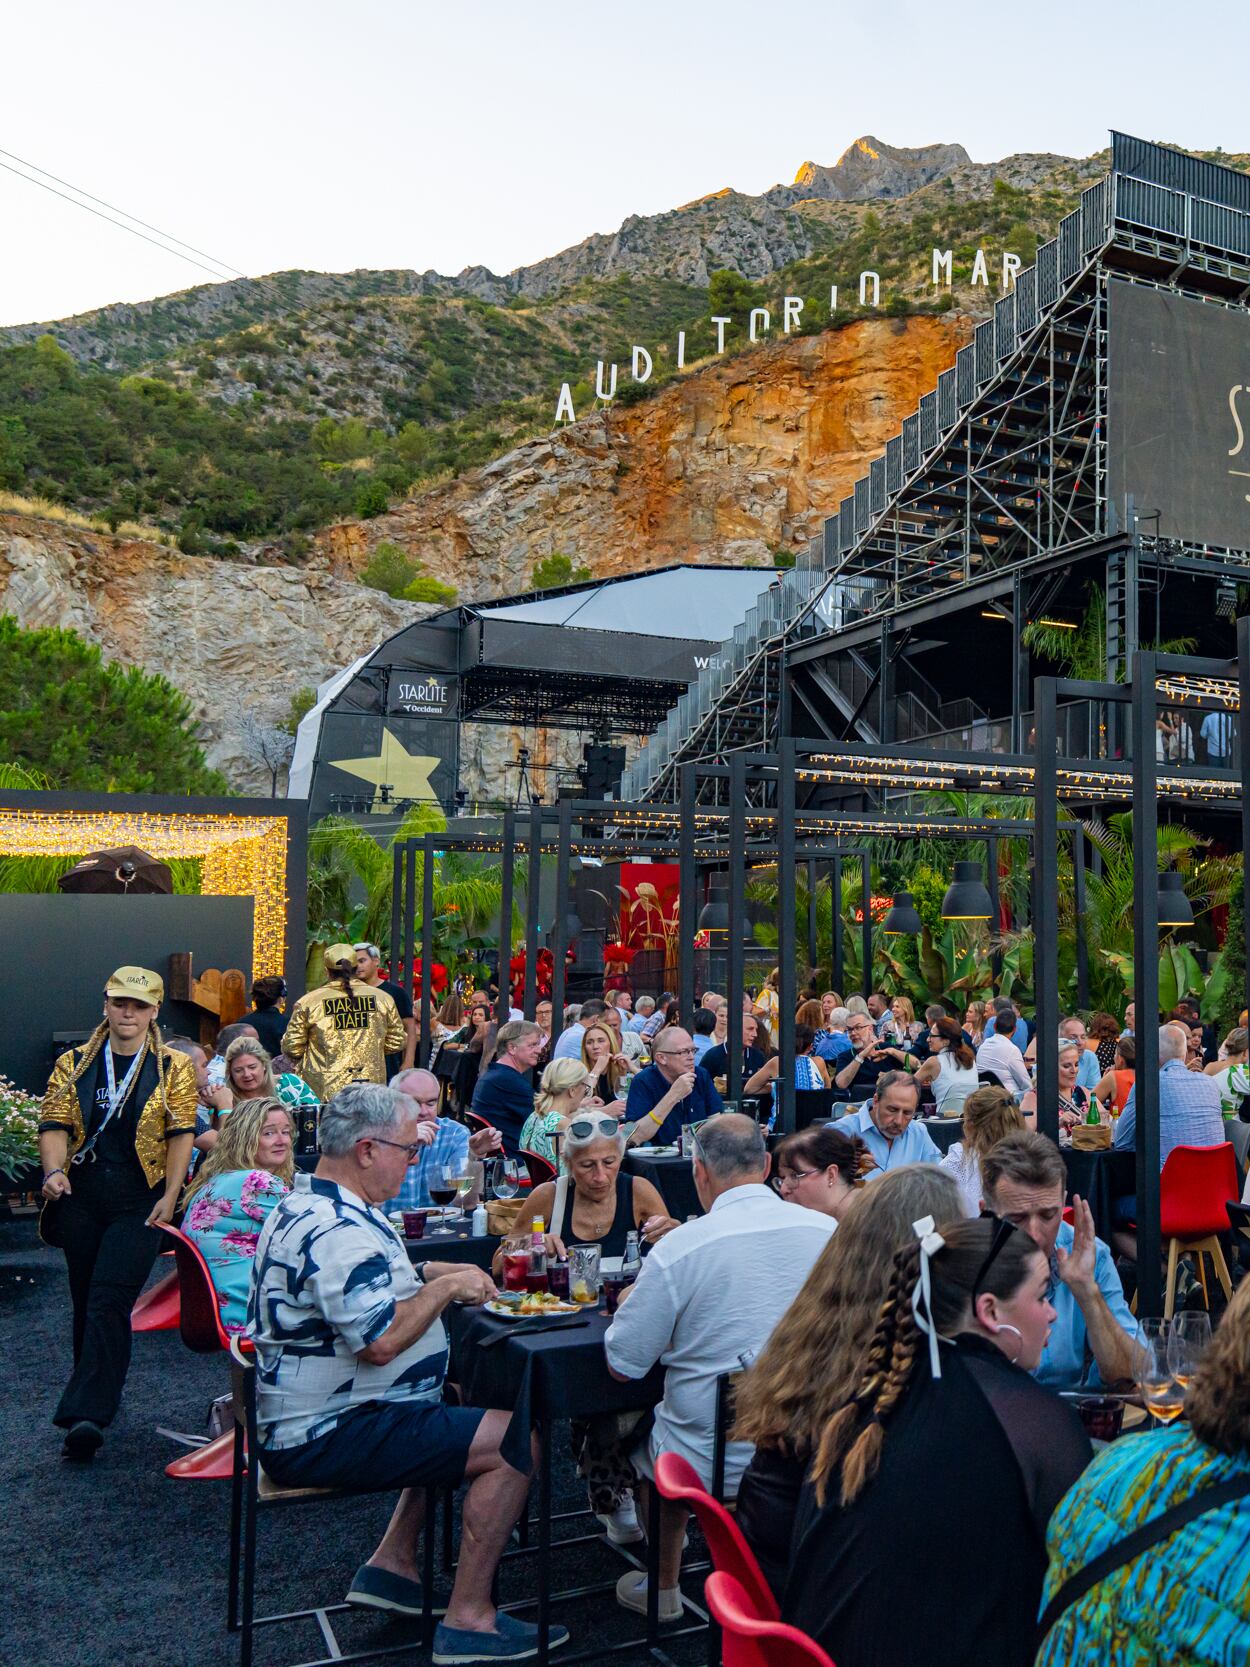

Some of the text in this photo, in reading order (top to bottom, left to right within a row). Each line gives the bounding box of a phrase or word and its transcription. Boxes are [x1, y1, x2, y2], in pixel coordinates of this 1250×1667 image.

[555, 271, 880, 422] AUDITORIO
[398, 683, 448, 703] STARLITE
[411, 704, 443, 714] Occident
[336, 1012, 367, 1029] STAFF
